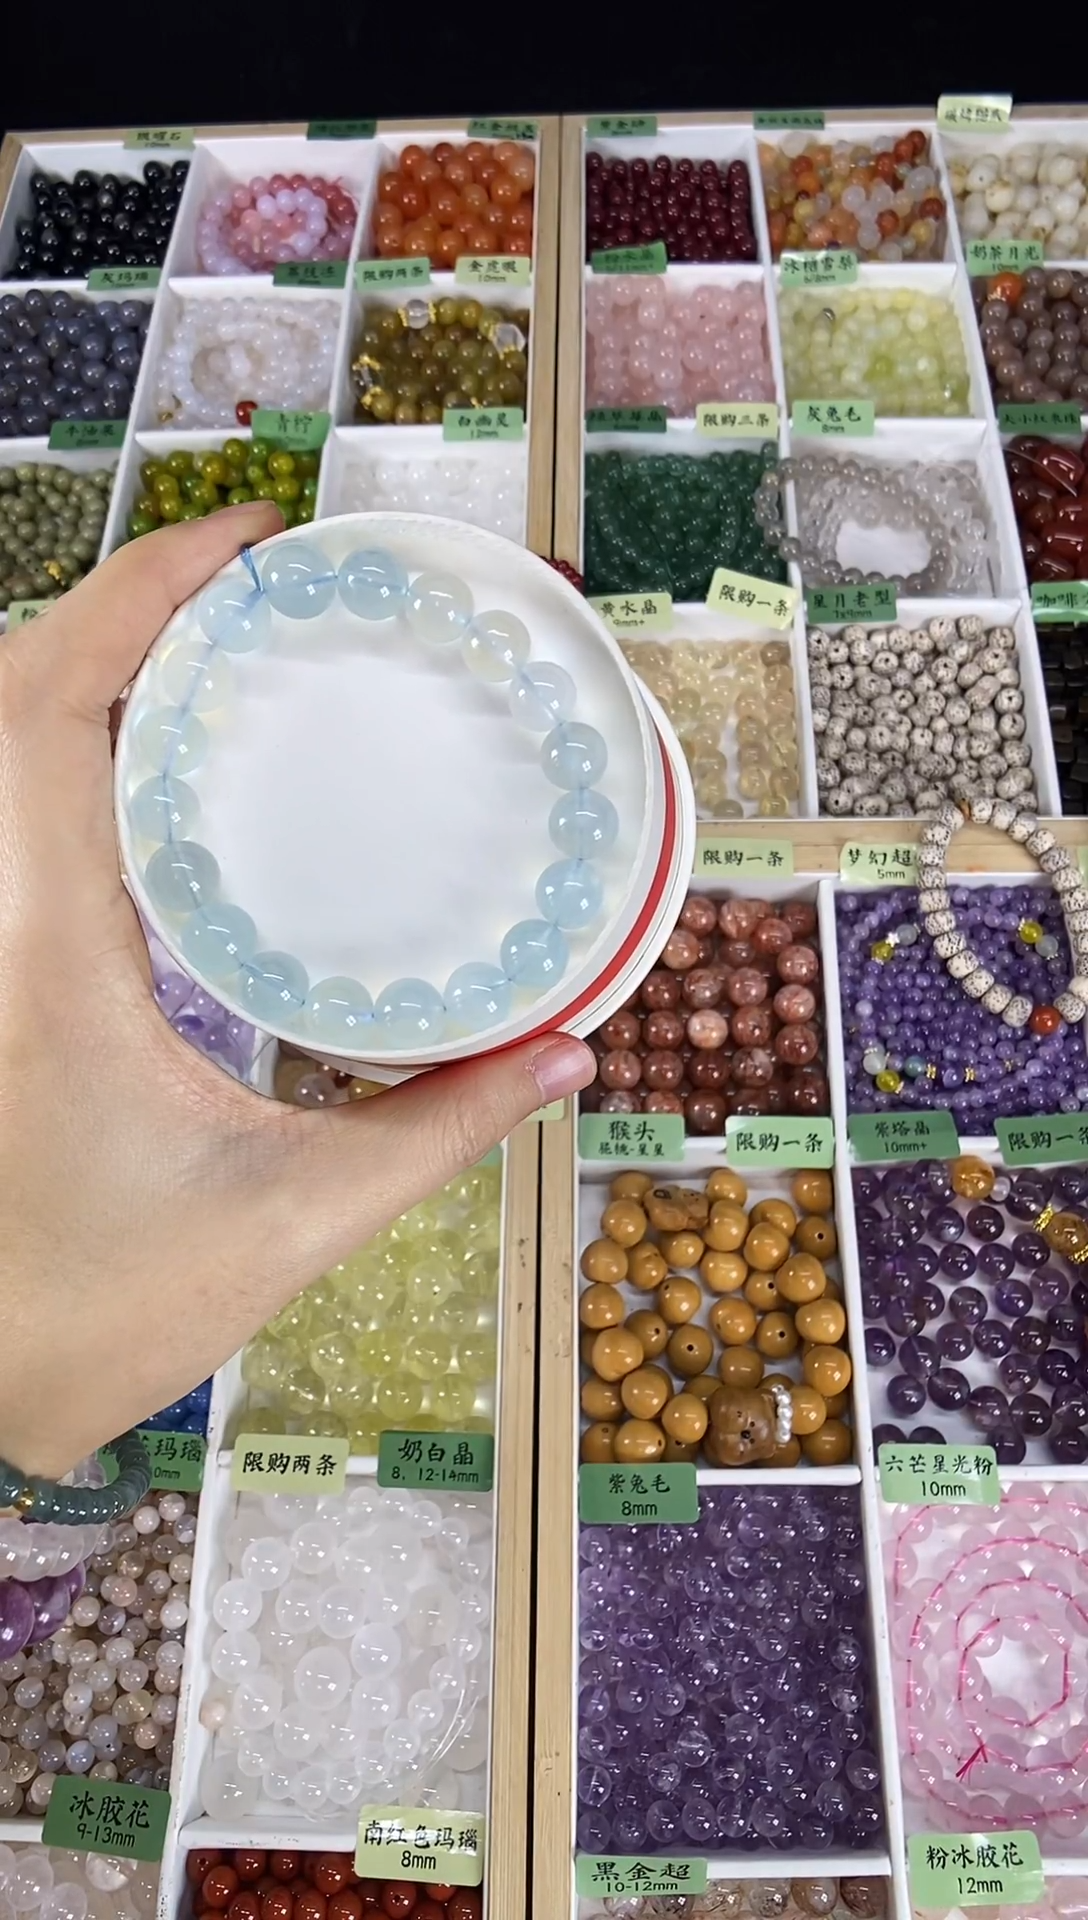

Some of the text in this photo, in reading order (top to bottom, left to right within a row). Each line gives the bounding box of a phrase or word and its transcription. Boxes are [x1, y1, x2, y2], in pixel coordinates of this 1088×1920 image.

[969, 245, 1040, 260] 奶茶月光
[703, 413, 770, 428] 限购三条
[807, 405, 862, 423] 灰兔毛
[600, 599, 658, 619] 黄水晶
[718, 583, 790, 617] 限购一条
[1035, 592, 1088, 609] 咖啡
[702, 848, 785, 867] 限购一条
[847, 847, 914, 867] 梦幻超
[876, 869, 906, 880] 5mm
[608, 1120, 656, 1142] 猴头
[874, 1120, 931, 1139] 紫塔晶
[736, 1131, 824, 1153] 限购一条
[884, 1141, 928, 1153] 10mm+
[397, 1438, 476, 1467] 奶白晶
[242, 1450, 338, 1476] 限购两条
[884, 1453, 995, 1477] 六芒星光粉
[608, 1473, 672, 1495] 紫兔毛
[920, 1480, 967, 1497] 10mm
[621, 1500, 659, 1517] 8mm
[69, 1793, 152, 1829] 冰胶花
[76, 1824, 137, 1849] 9-13mm
[363, 1820, 479, 1853] 南红色玛瑙
[400, 1854, 438, 1873] 8mm
[925, 1841, 1026, 1870] 粉冰胶花
[591, 1861, 693, 1882] 黑金超
[604, 1882, 680, 1894] 10-12mm
[956, 1876, 1005, 1895] 12mm
